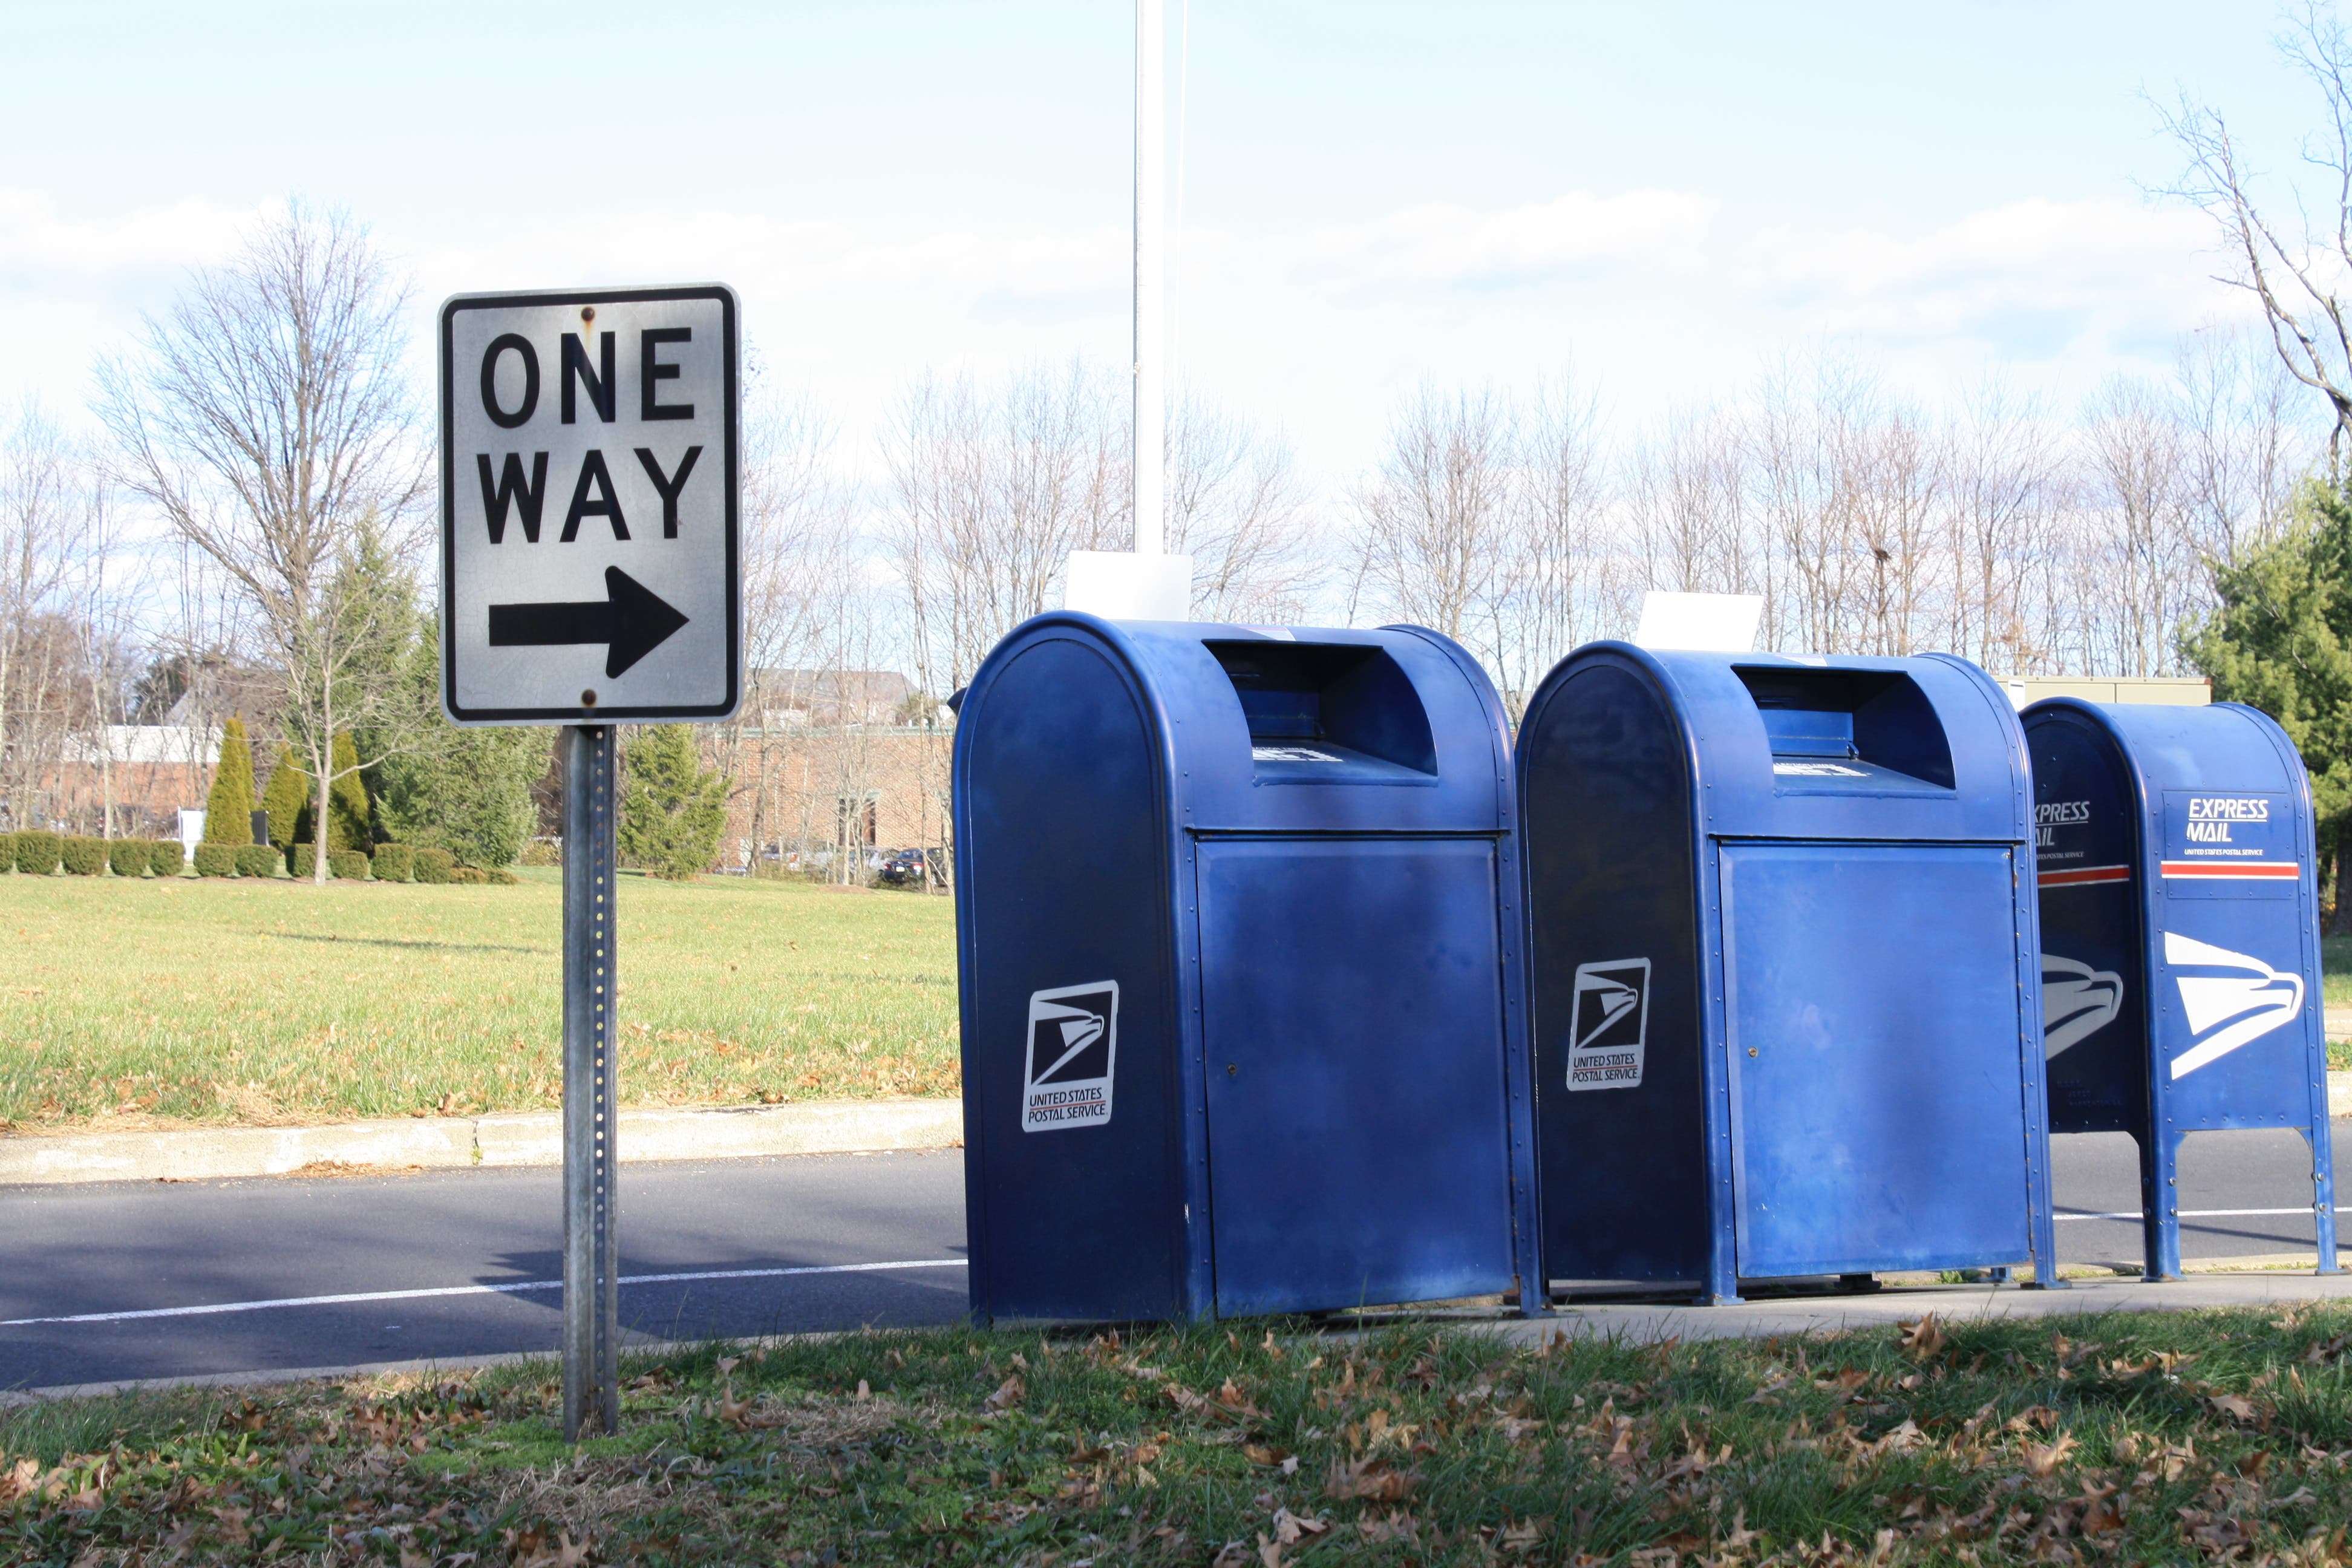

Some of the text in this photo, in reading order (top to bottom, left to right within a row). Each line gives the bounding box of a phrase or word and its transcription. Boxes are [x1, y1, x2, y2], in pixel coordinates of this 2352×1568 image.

[480, 327, 695, 429] ONE
[476, 445, 704, 544] WAY
[2034, 801, 2090, 823] XPRESS
[2188, 798, 2269, 818] EXPRESS
[2035, 827, 2055, 847] AIL
[2186, 822, 2232, 842] MAIL
[1573, 1053, 1635, 1068] UNITED STATES
[1572, 1068, 1638, 1083] POSTAL SERVICE
[1030, 1087, 1102, 1107] UNITED STATES
[1028, 1103, 1106, 1123] POSTAL SERVICE
